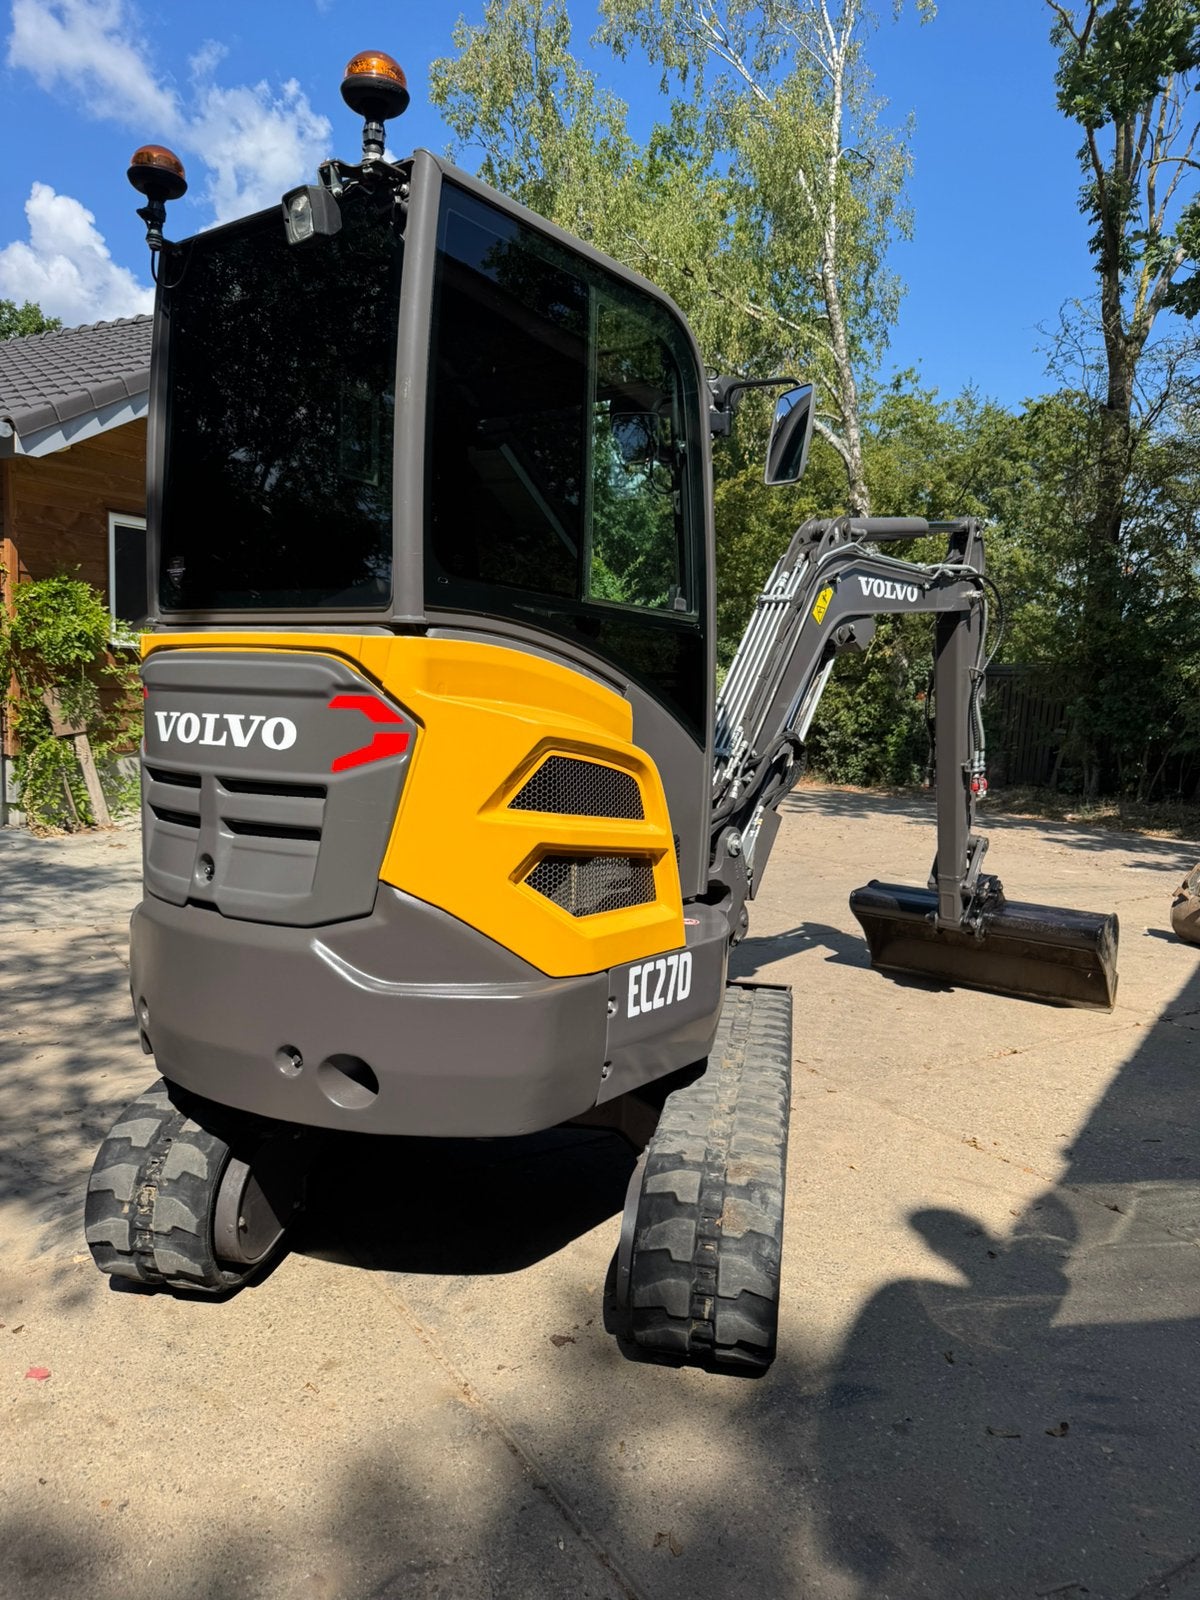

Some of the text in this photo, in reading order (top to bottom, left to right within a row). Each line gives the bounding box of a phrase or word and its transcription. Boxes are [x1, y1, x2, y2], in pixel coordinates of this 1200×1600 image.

[857, 576, 918, 602] VOLVO
[154, 711, 297, 750] VOLVO
[628, 951, 692, 1018] EC27D
